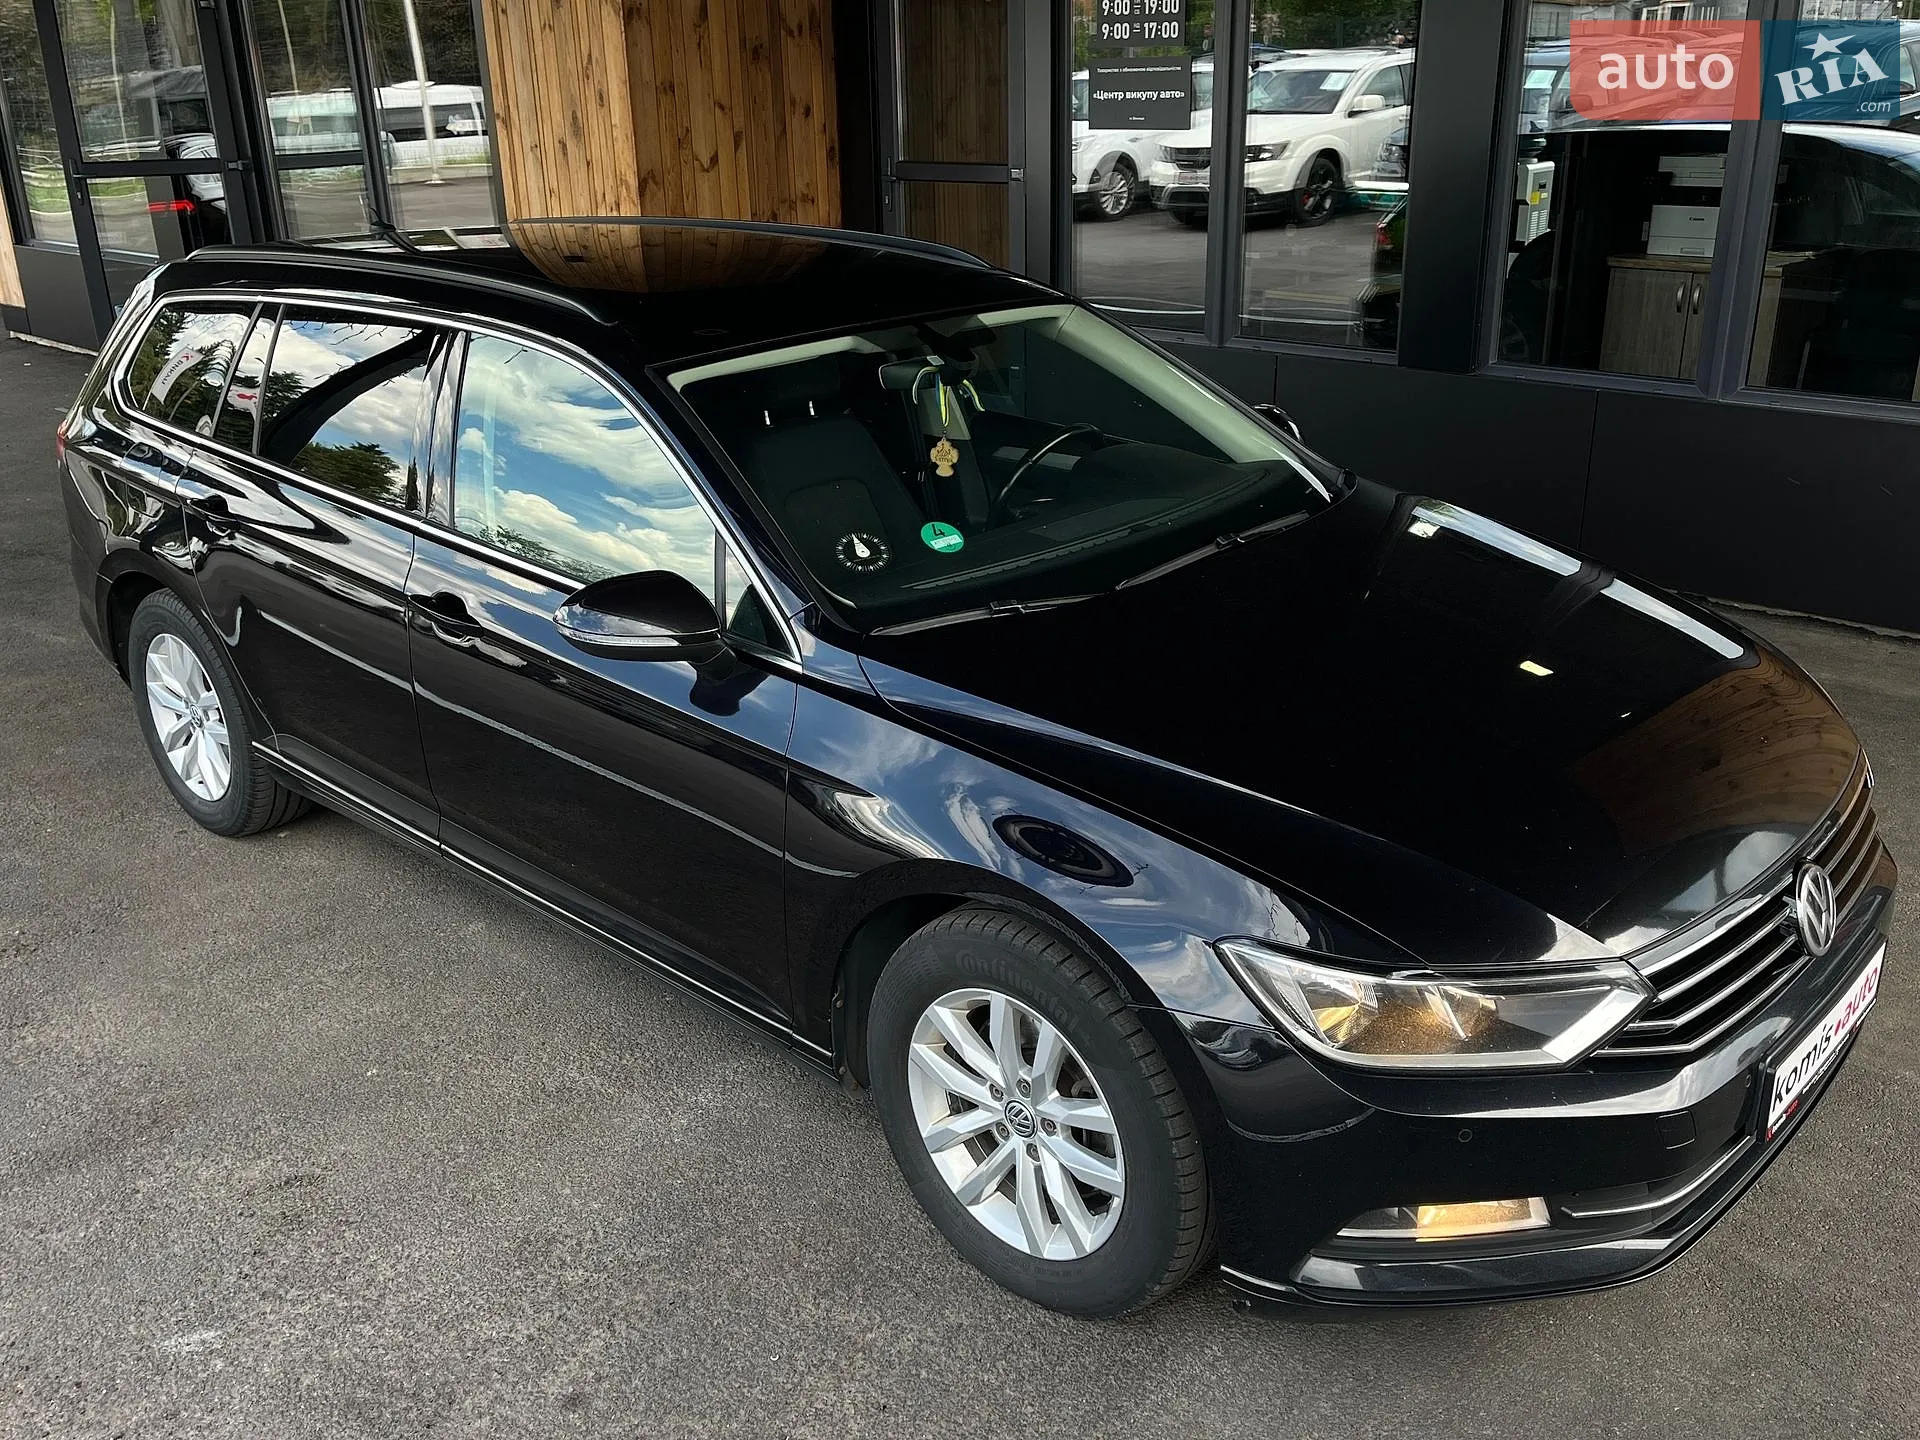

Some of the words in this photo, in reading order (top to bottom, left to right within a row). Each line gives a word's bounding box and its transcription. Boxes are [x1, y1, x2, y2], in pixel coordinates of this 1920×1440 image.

[1102, 0, 1130, 16] 9:00
[1144, 0, 1179, 15] 19:00
[1101, 23, 1130, 39] 9:00
[1143, 21, 1179, 39] 17:00
[1125, 90, 1159, 101] викупу
[931, 523, 946, 537] 4
[1772, 1023, 1834, 1112] komis
